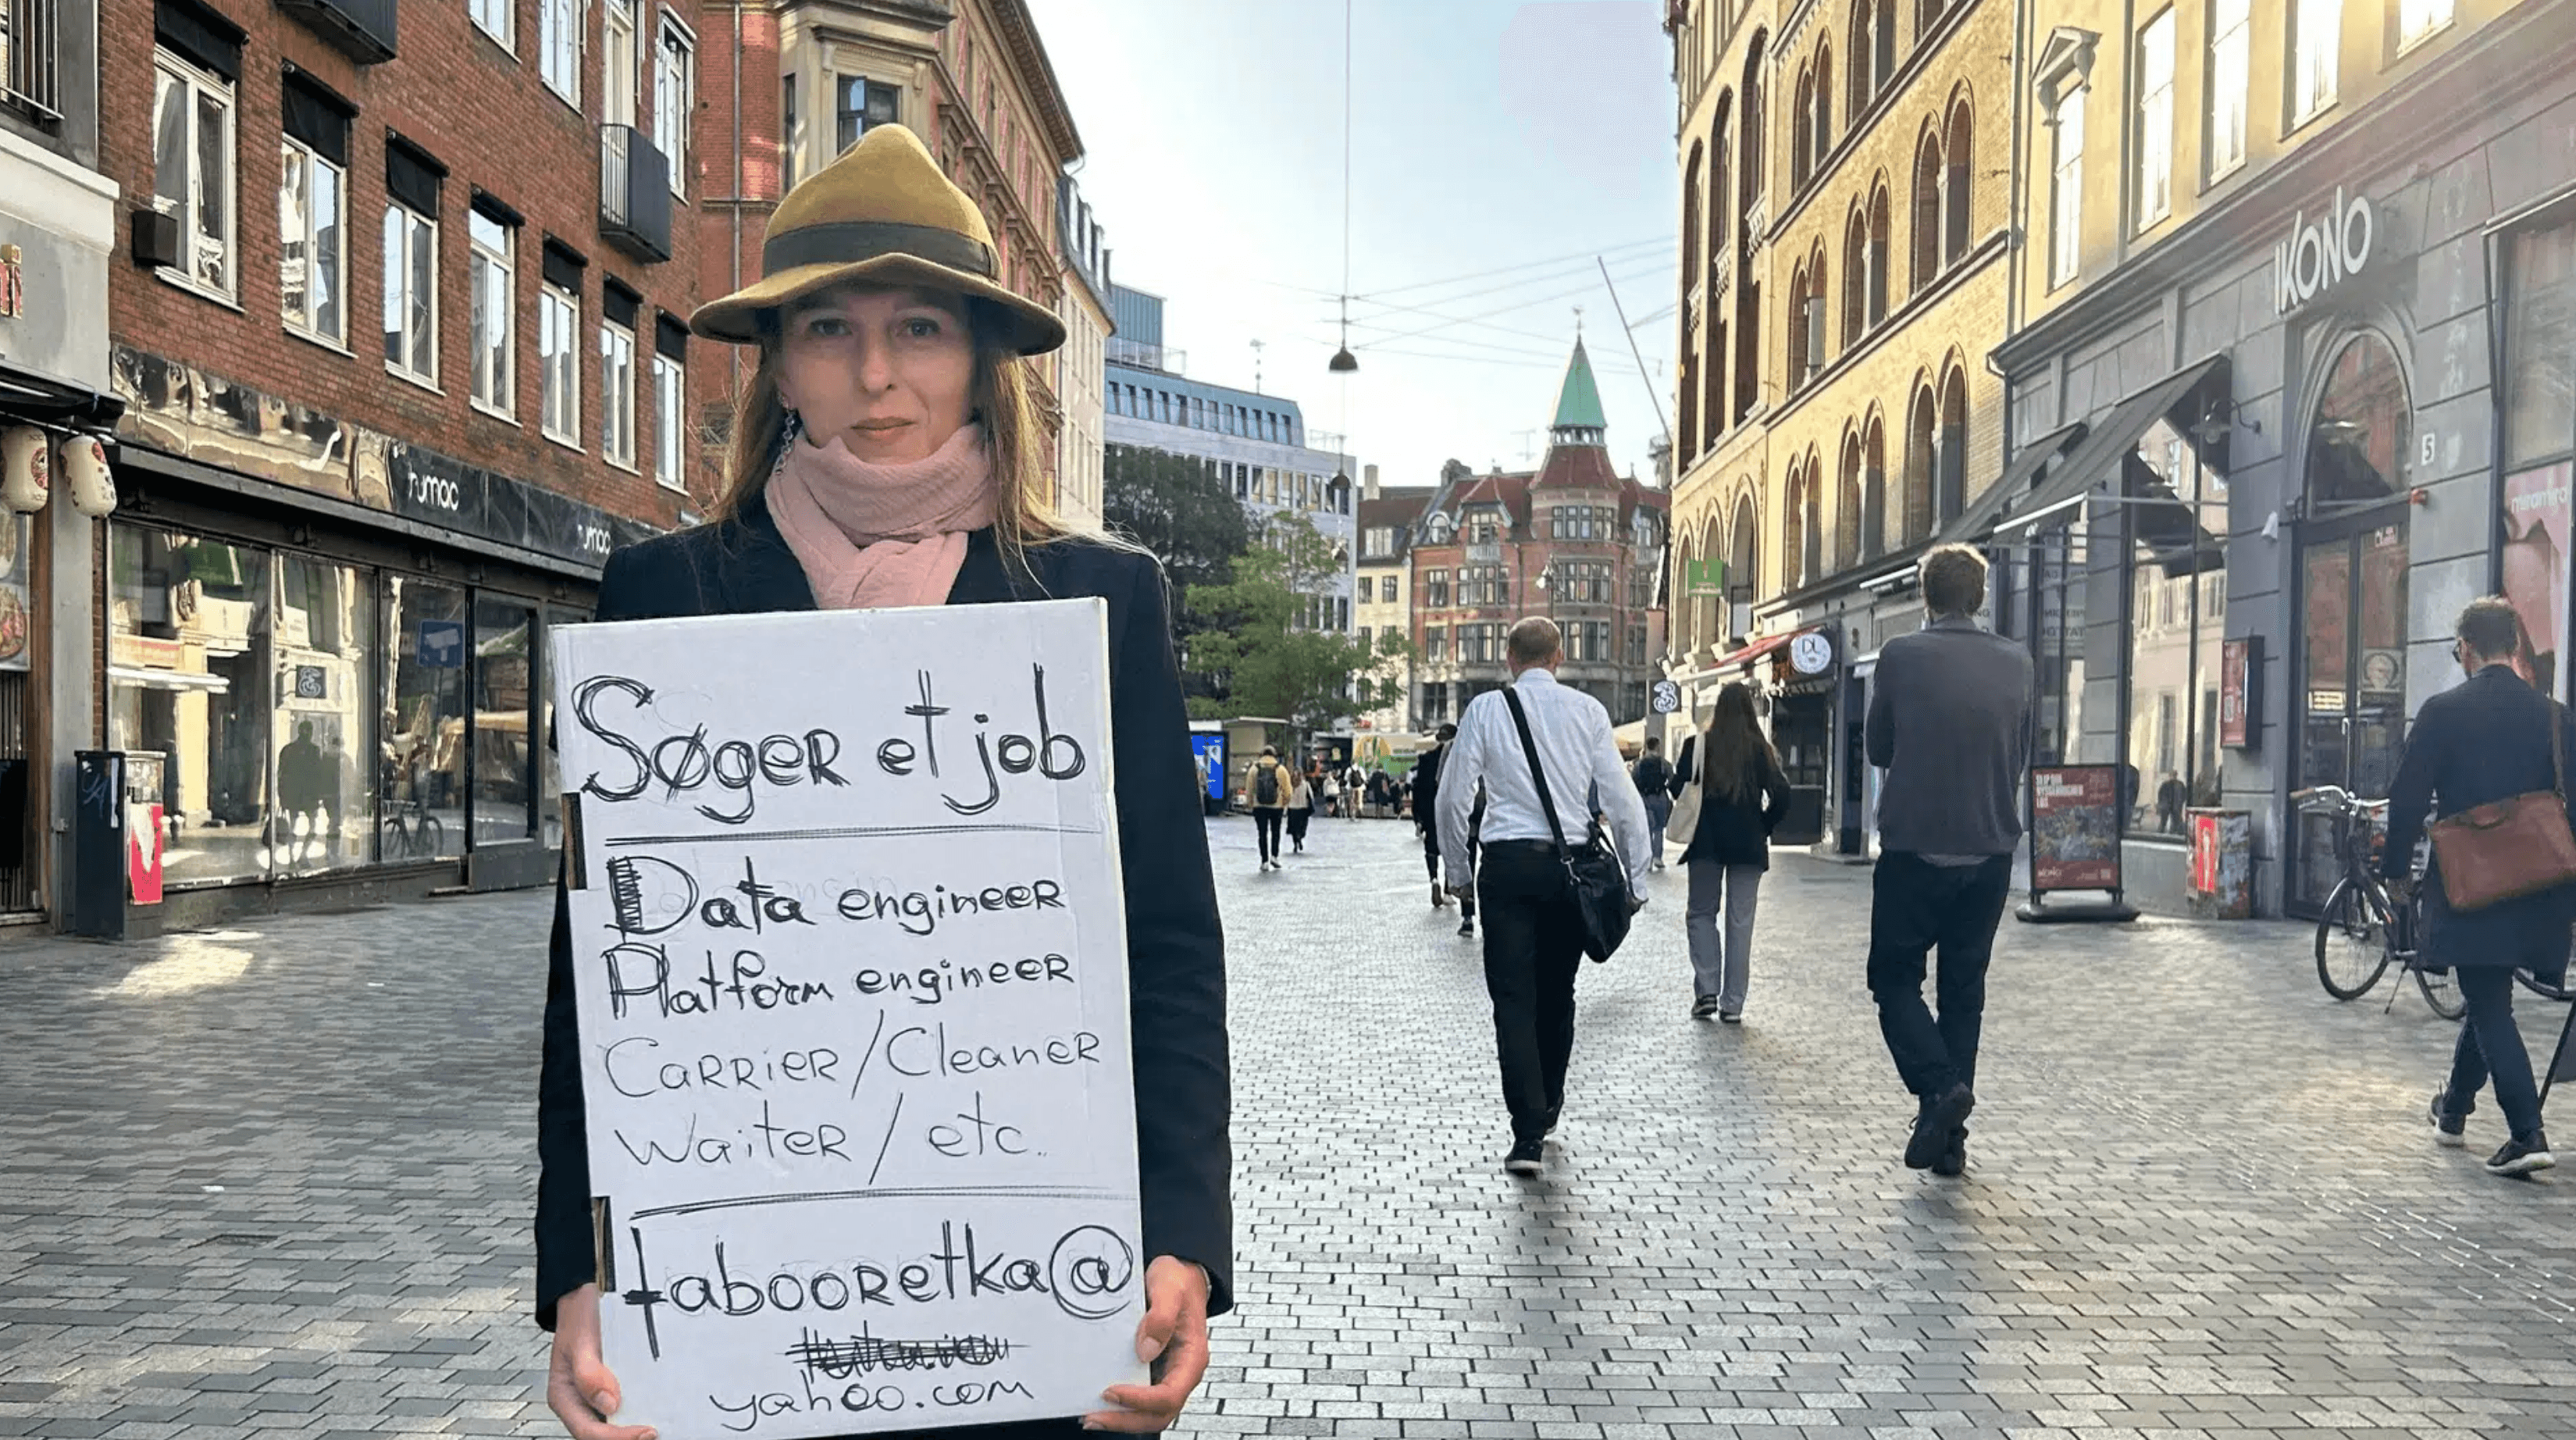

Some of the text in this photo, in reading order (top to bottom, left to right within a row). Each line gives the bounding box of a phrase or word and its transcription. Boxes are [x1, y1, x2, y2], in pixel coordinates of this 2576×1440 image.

[2275, 184, 2372, 315] IKONO
[2425, 437, 2433, 462] 5
[1653, 681, 1678, 713] 3
[877, 668, 952, 779] et
[940, 661, 1086, 815] job
[604, 855, 818, 943] Data
[708, 1368, 1035, 1432] yahoo.com
